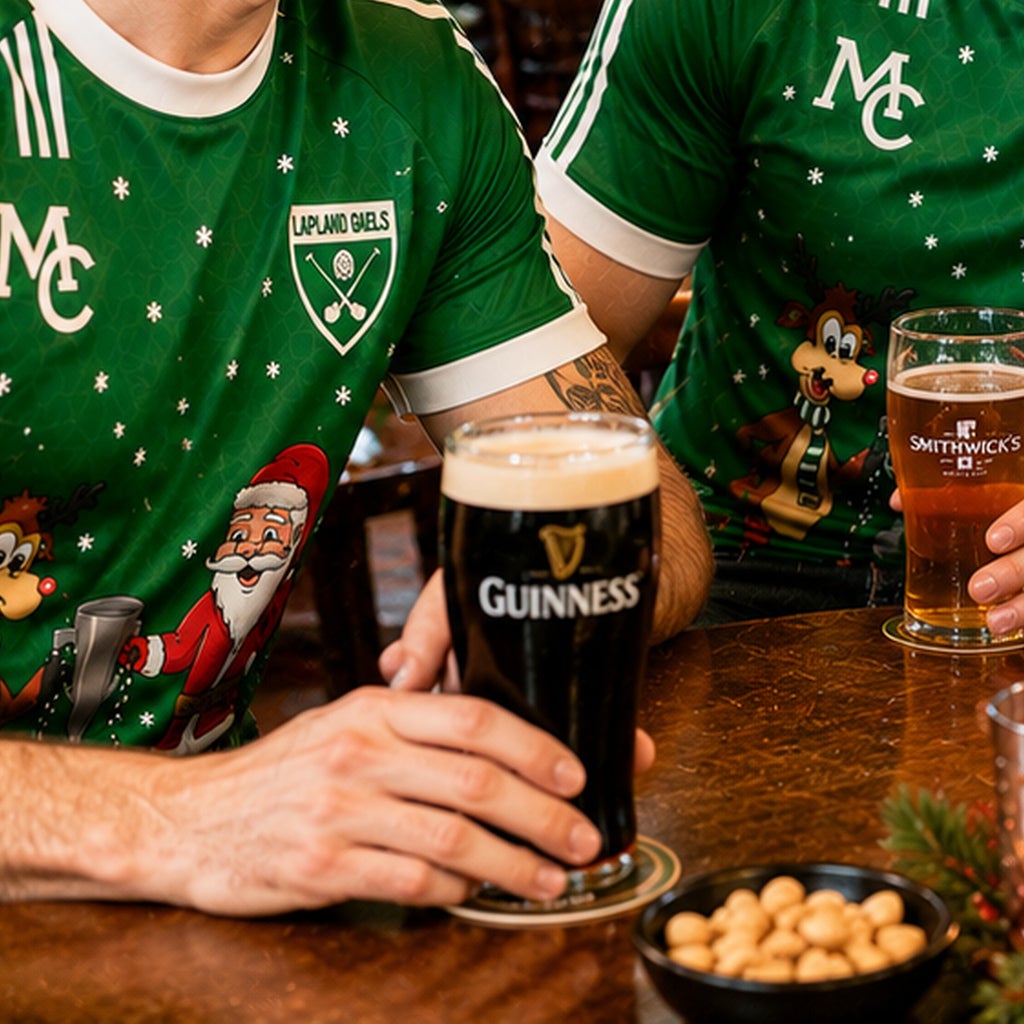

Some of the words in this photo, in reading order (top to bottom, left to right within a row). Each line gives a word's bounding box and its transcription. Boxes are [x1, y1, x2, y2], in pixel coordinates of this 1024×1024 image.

[292, 212, 348, 236] LAPLAND
[910, 433, 1021, 454] SMITHWICK'S
[478, 573, 640, 620] GUINNESS
